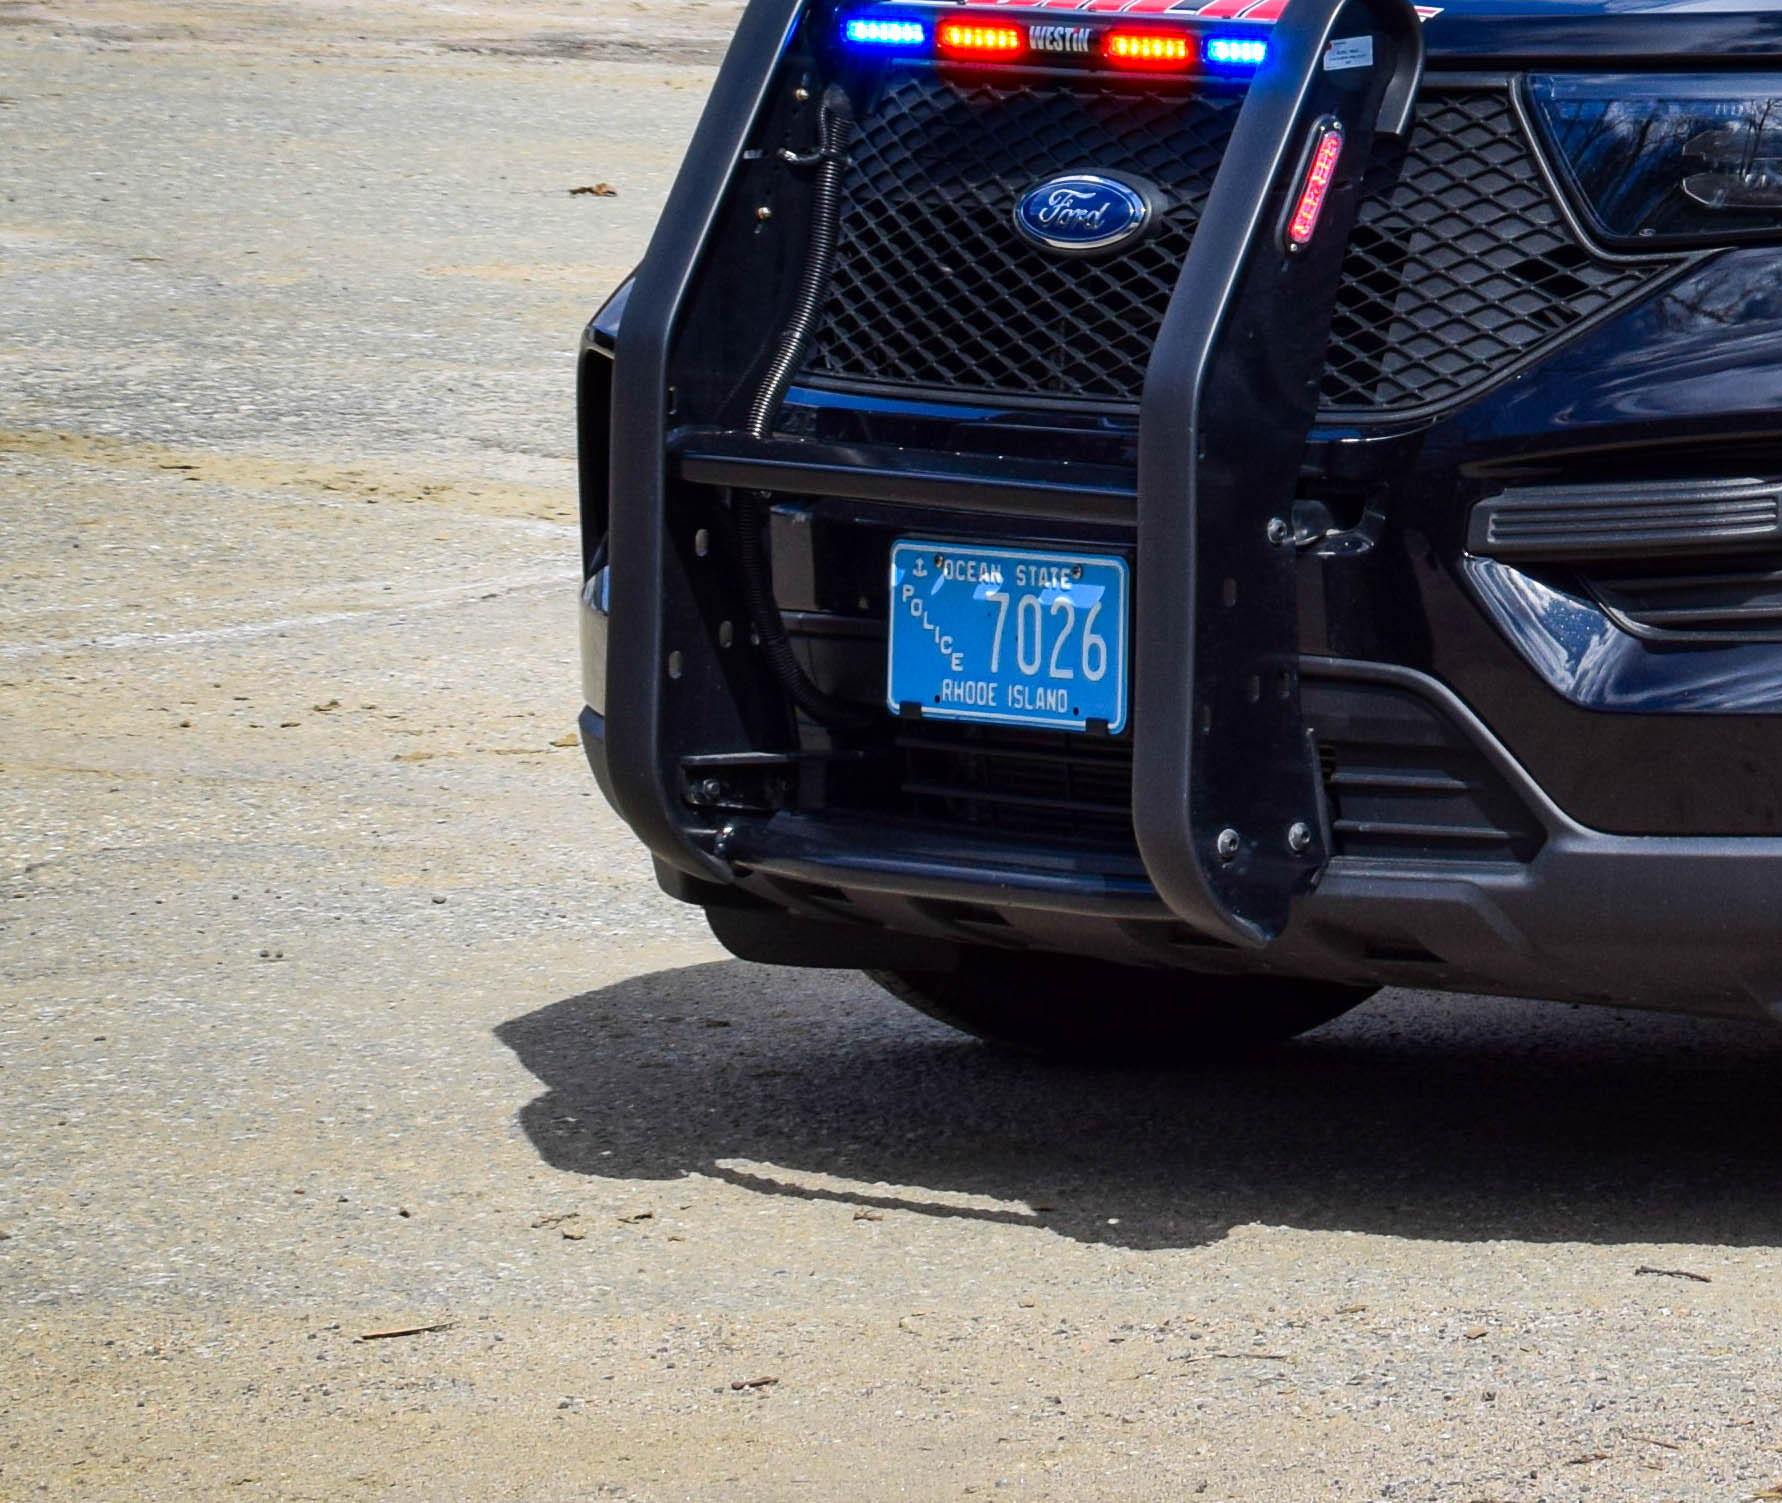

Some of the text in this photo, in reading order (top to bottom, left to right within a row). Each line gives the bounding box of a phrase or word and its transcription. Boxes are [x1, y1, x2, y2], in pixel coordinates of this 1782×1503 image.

[1039, 188, 1112, 230] Ford
[943, 559, 1072, 590] OCEAN STATE
[902, 583, 965, 672] POLICE
[985, 592, 1108, 682] 7026
[941, 678, 1068, 713] RHODE ISLAND
